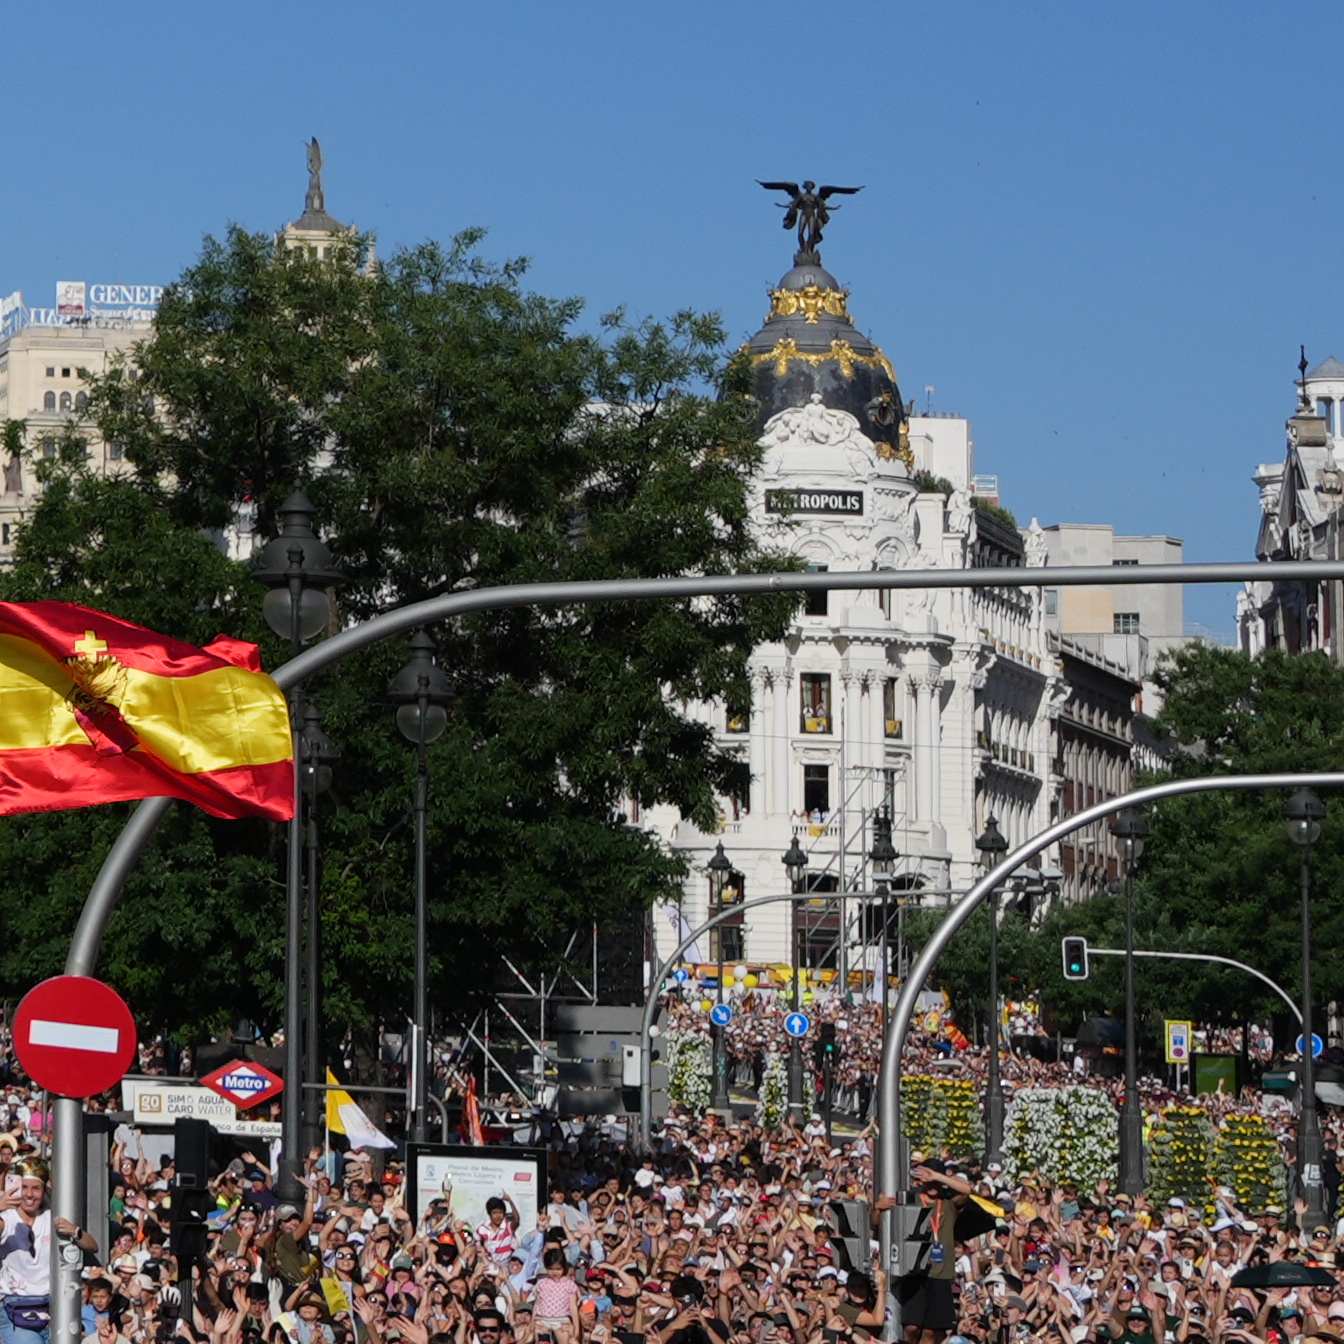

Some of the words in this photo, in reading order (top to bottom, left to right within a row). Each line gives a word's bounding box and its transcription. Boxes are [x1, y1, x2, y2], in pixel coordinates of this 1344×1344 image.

[225, 1076, 263, 1089] Metro
[167, 1095, 186, 1104] SIM
[198, 1096, 225, 1105] AGUA
[167, 1105, 194, 1114] CARD
[198, 1105, 232, 1116] WATER
[236, 1123, 246, 1132] de
[251, 1124, 281, 1135] España
